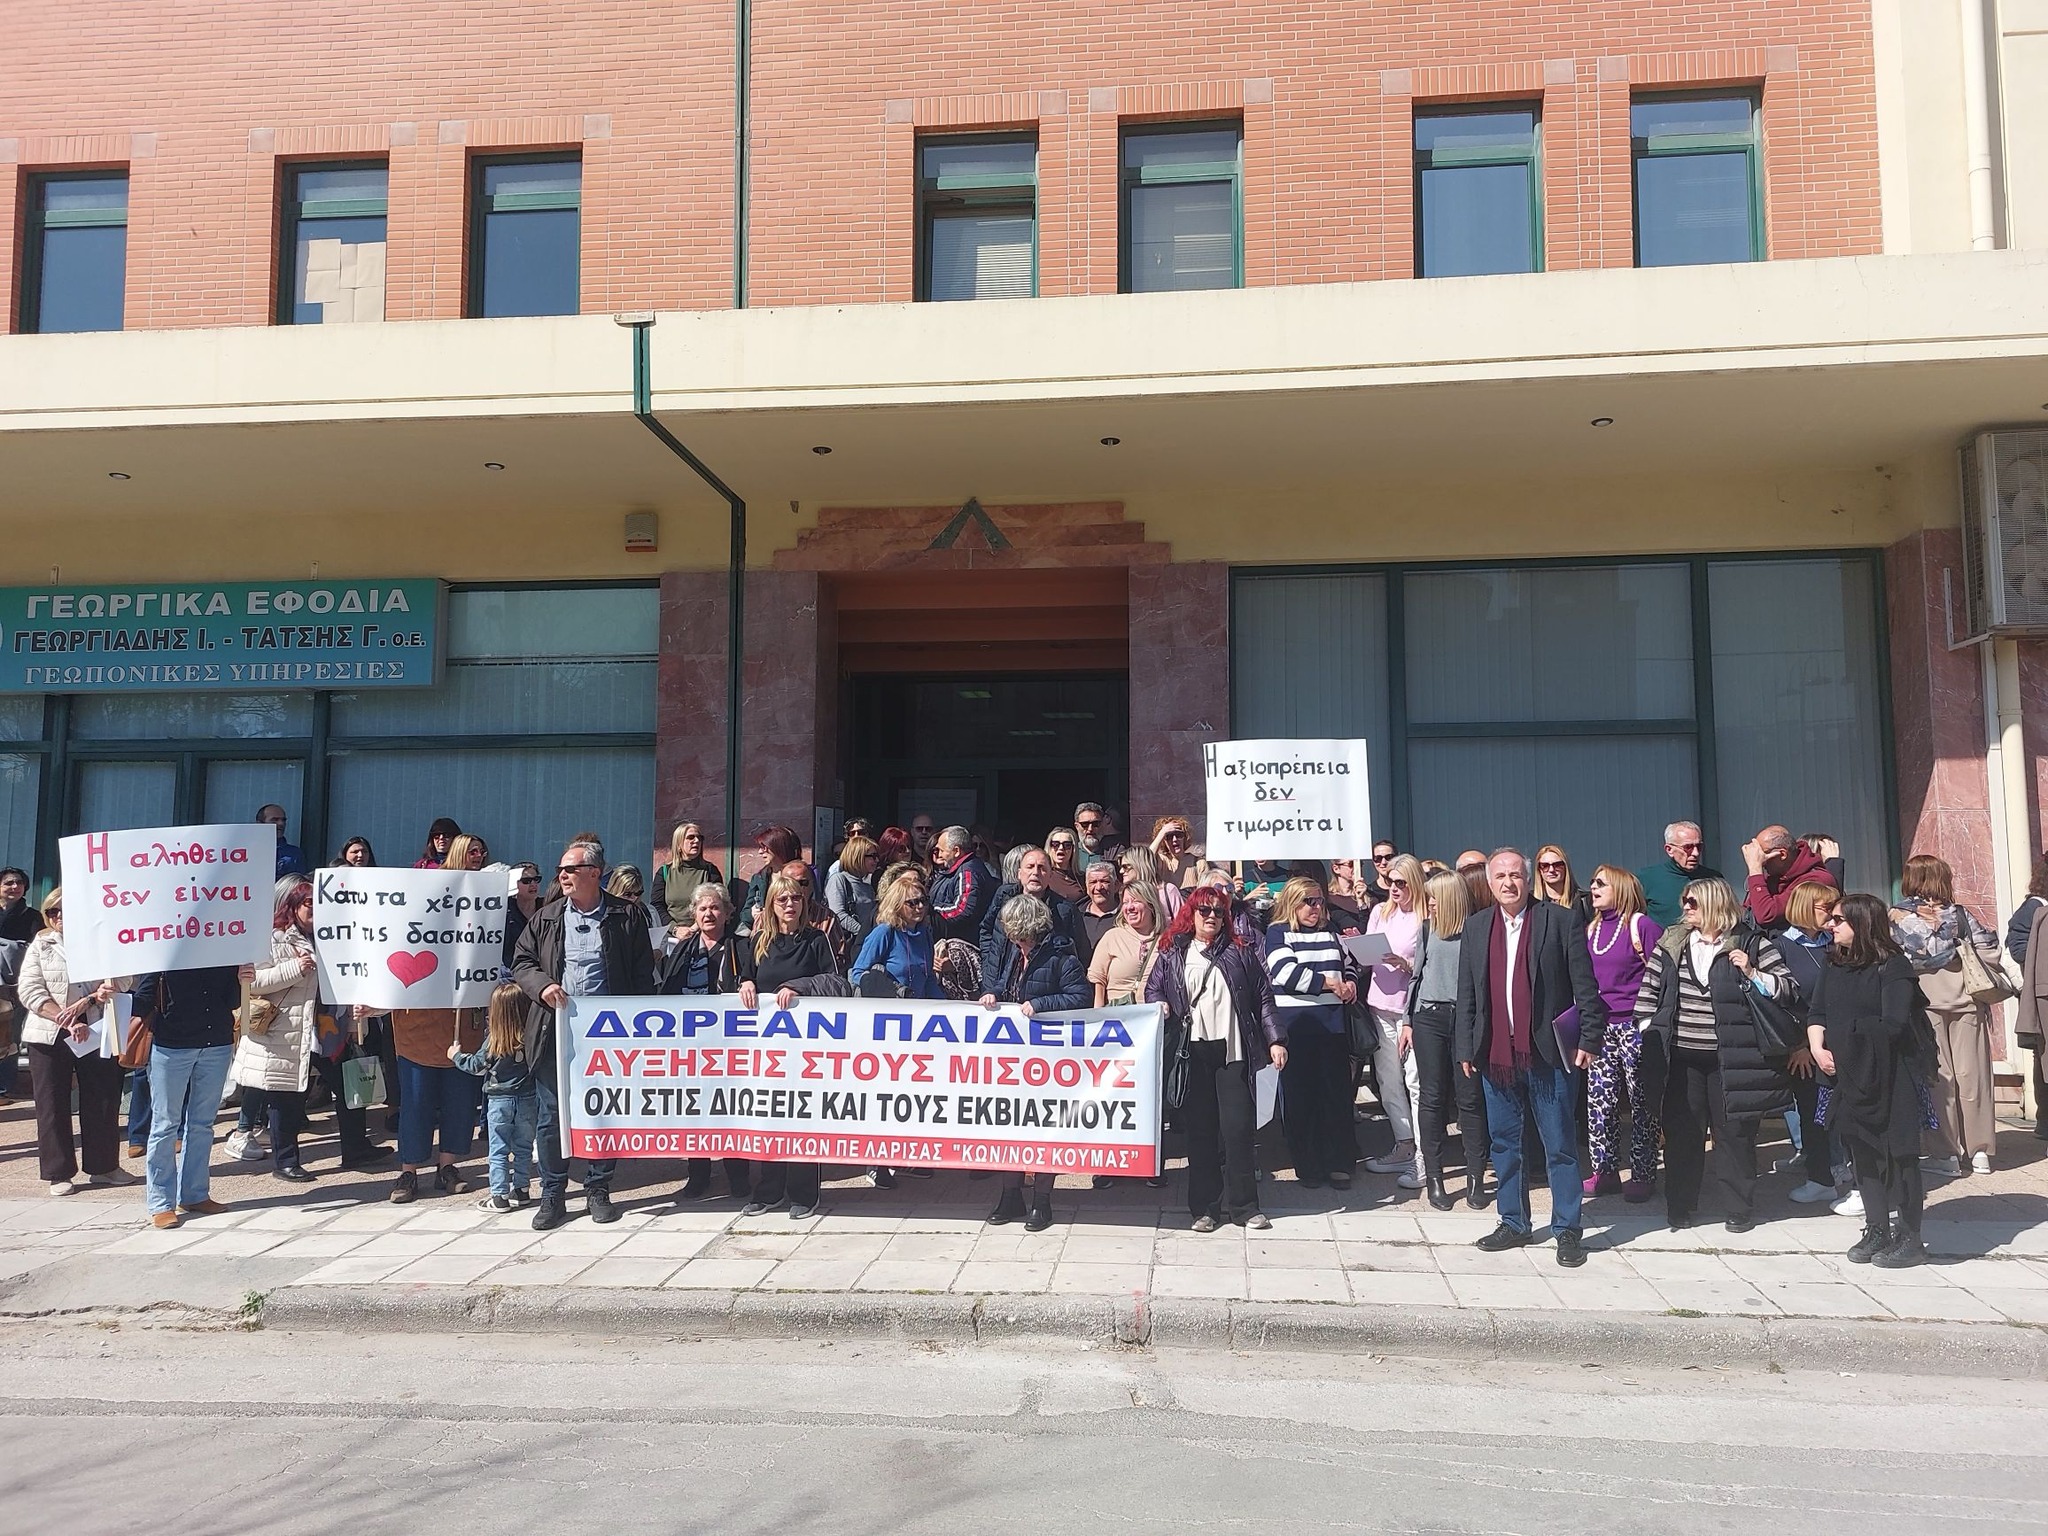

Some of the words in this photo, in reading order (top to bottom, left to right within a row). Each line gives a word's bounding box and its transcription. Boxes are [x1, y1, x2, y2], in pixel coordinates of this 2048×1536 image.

[27, 592, 232, 619] ΓΕΩΡΓΙΚΑ
[247, 588, 410, 615] ΕΦΟΔΙΑ
[14, 628, 189, 653] ΓΕΩΡΓΙΑΔΗΣ
[241, 625, 354, 650] ΤΑΤΣΗΣ
[361, 624, 387, 648] Γ.
[392, 632, 426, 648] Ο.Ε.
[25, 663, 220, 684] ΓΕΩΠΟΝΙΚΕΣ
[229, 661, 405, 681] ΥΠΗΡΕΣΙΕΣ
[1205, 744, 1217, 778] Η
[1224, 754, 1350, 780] αξιοπρέπεια
[1255, 782, 1294, 801] δεν
[1224, 809, 1344, 840] τιμωρείται
[87, 832, 109, 873] Η
[130, 842, 249, 867] αλήθεια
[102, 884, 151, 908] δεν
[174, 876, 252, 902] είναι
[318, 872, 368, 905] Κάτω
[375, 890, 407, 907] τα
[425, 887, 503, 917] χέρια
[118, 914, 247, 944] απείθεια
[362, 926, 388, 942] τις
[406, 922, 503, 945] δασκάλες
[336, 962, 369, 978] της
[455, 967, 500, 990] μας
[585, 1009, 848, 1040] ΔΩΡΕΑΝ
[872, 1013, 1135, 1048] ΠΑΙΔΕΙΑ
[585, 1049, 787, 1078] ΑΥΞΗΣΕΙΣ
[801, 1051, 934, 1082] ΣΤΟΥΣ
[950, 1055, 1136, 1088] ΜΙΣΘΟΥΣ
[584, 1087, 631, 1117] ΟΧΙ
[641, 1088, 701, 1116] ΣΤΙΣ
[709, 1088, 812, 1119] ΔΙΩΞΕΙΣ
[822, 1091, 866, 1121] ΚΑΙ
[877, 1093, 949, 1124] ΤΟΥΣ
[957, 1096, 1137, 1130] ΕΚΒΙΑΣΜΟΥΣ
[585, 1134, 680, 1152] ΣΥΛΛΟΓΟΣ
[686, 1135, 829, 1156] ΕΚΠΑΙΔΕΥΤΙΚΩΝ
[837, 1139, 858, 1157] ΠΕ
[865, 1140, 943, 1161] ΛΑΡΙΣΑΣ
